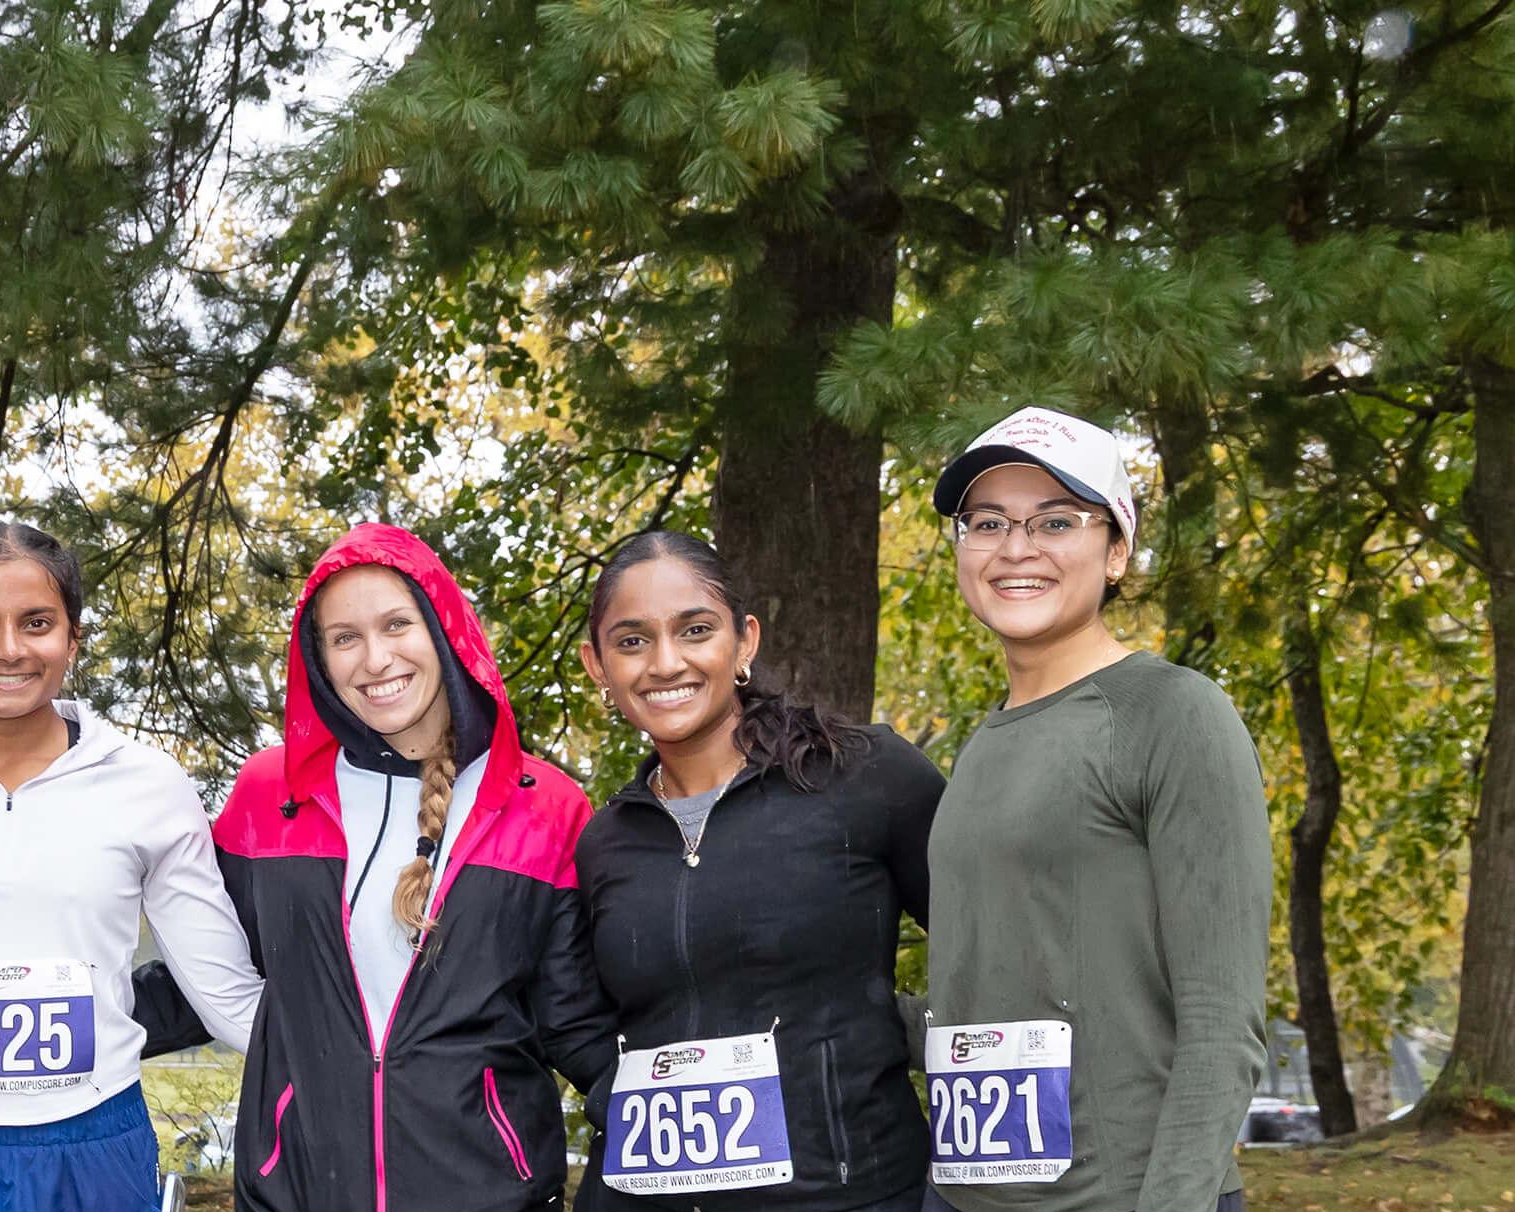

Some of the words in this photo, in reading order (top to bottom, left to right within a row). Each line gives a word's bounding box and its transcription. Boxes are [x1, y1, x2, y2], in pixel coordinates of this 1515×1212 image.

[621, 1085, 761, 1169] 2652
[931, 1073, 1045, 1157] 2621
[630, 1176, 659, 1189] RESULTS
[659, 1176, 668, 1188] @
[670, 1167, 776, 1187] WWW.COMPUSCORE.COM
